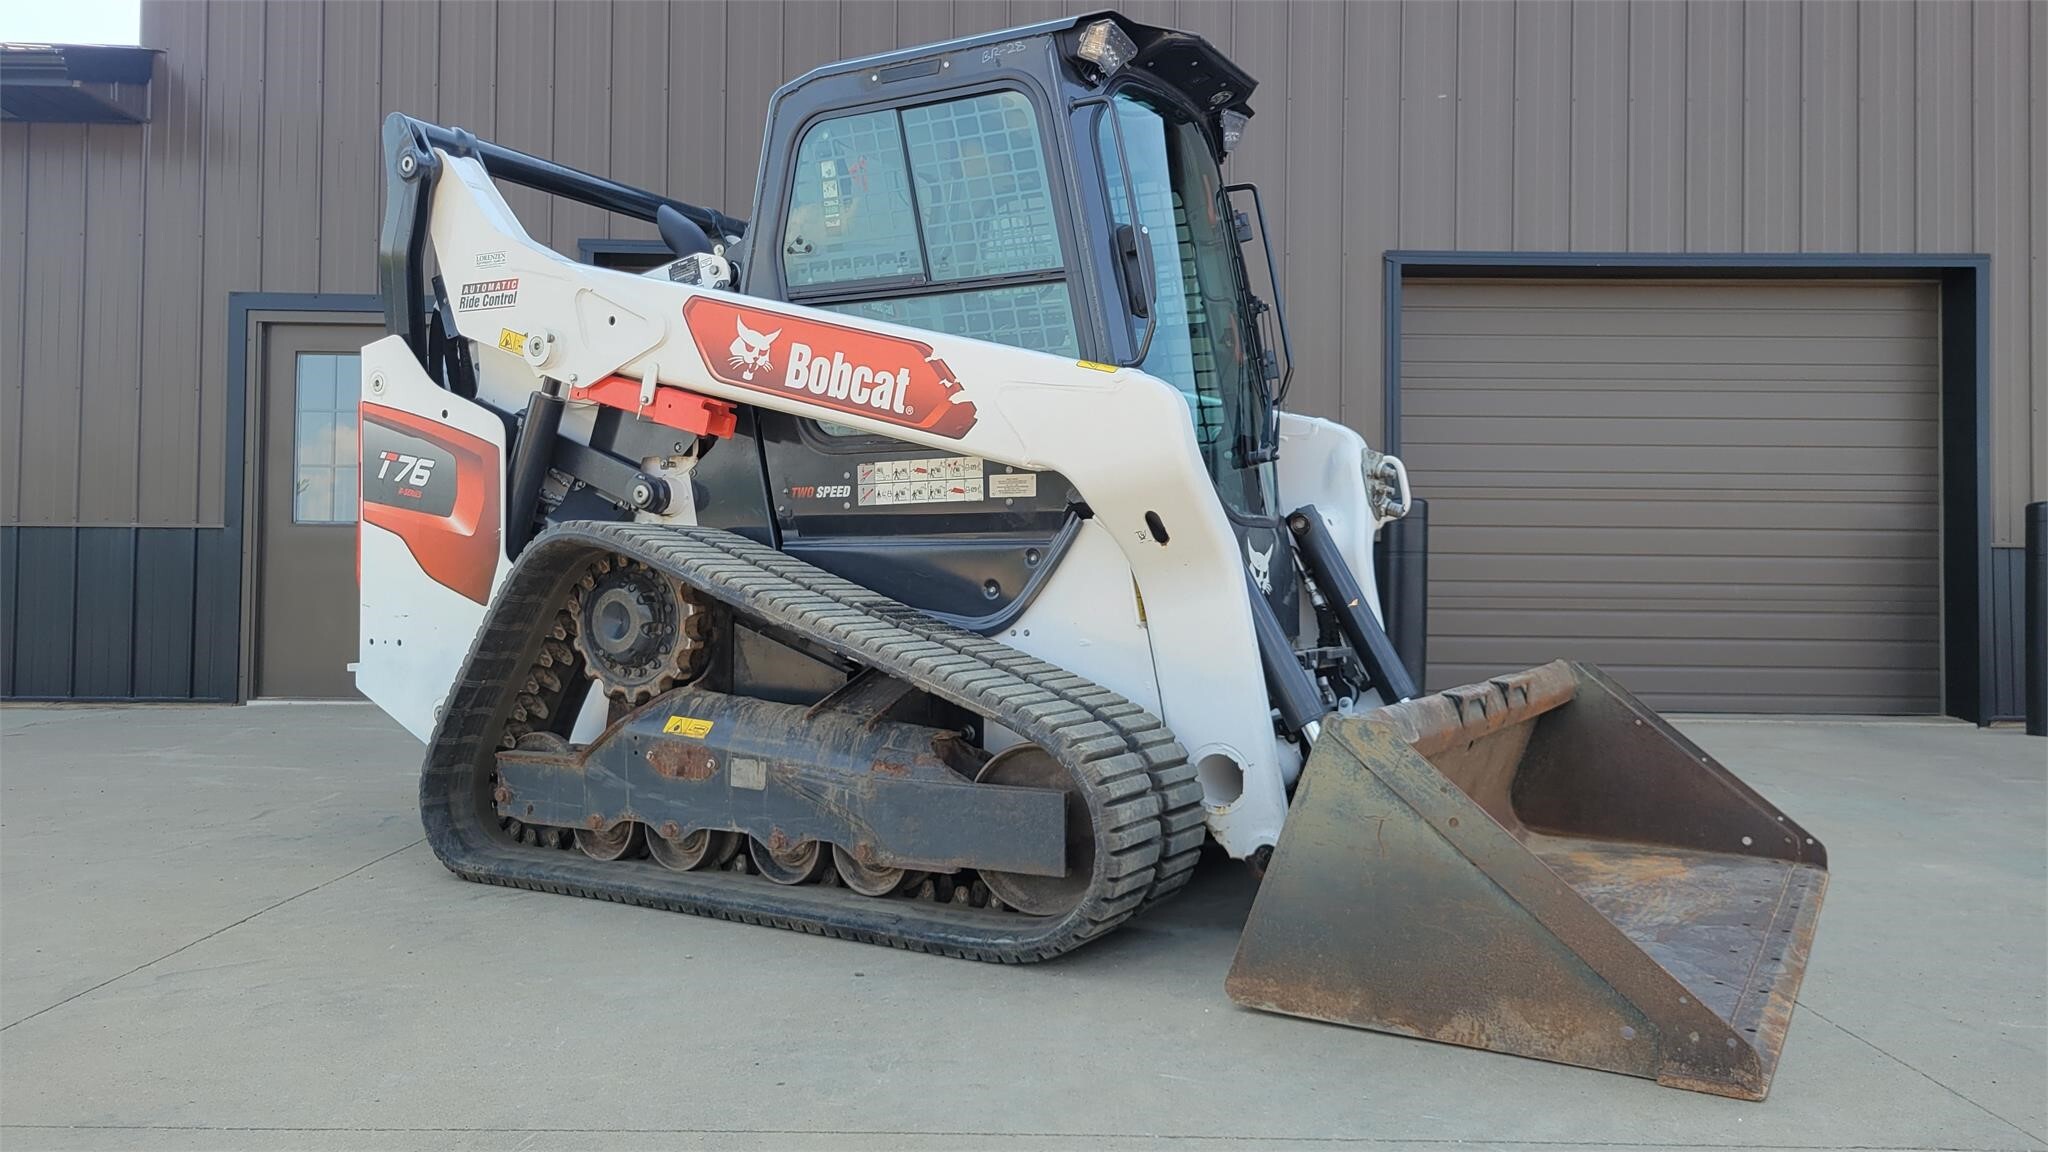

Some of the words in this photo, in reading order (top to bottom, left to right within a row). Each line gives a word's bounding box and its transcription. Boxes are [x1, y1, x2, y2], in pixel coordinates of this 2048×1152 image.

[463, 280, 518, 295] AUTOMATIC
[459, 295, 481, 310] Ride
[482, 291, 518, 307] Control
[784, 342, 911, 414] Bobcat
[377, 451, 436, 487] T76
[791, 486, 815, 498] TWO
[816, 485, 851, 498] SPEED
